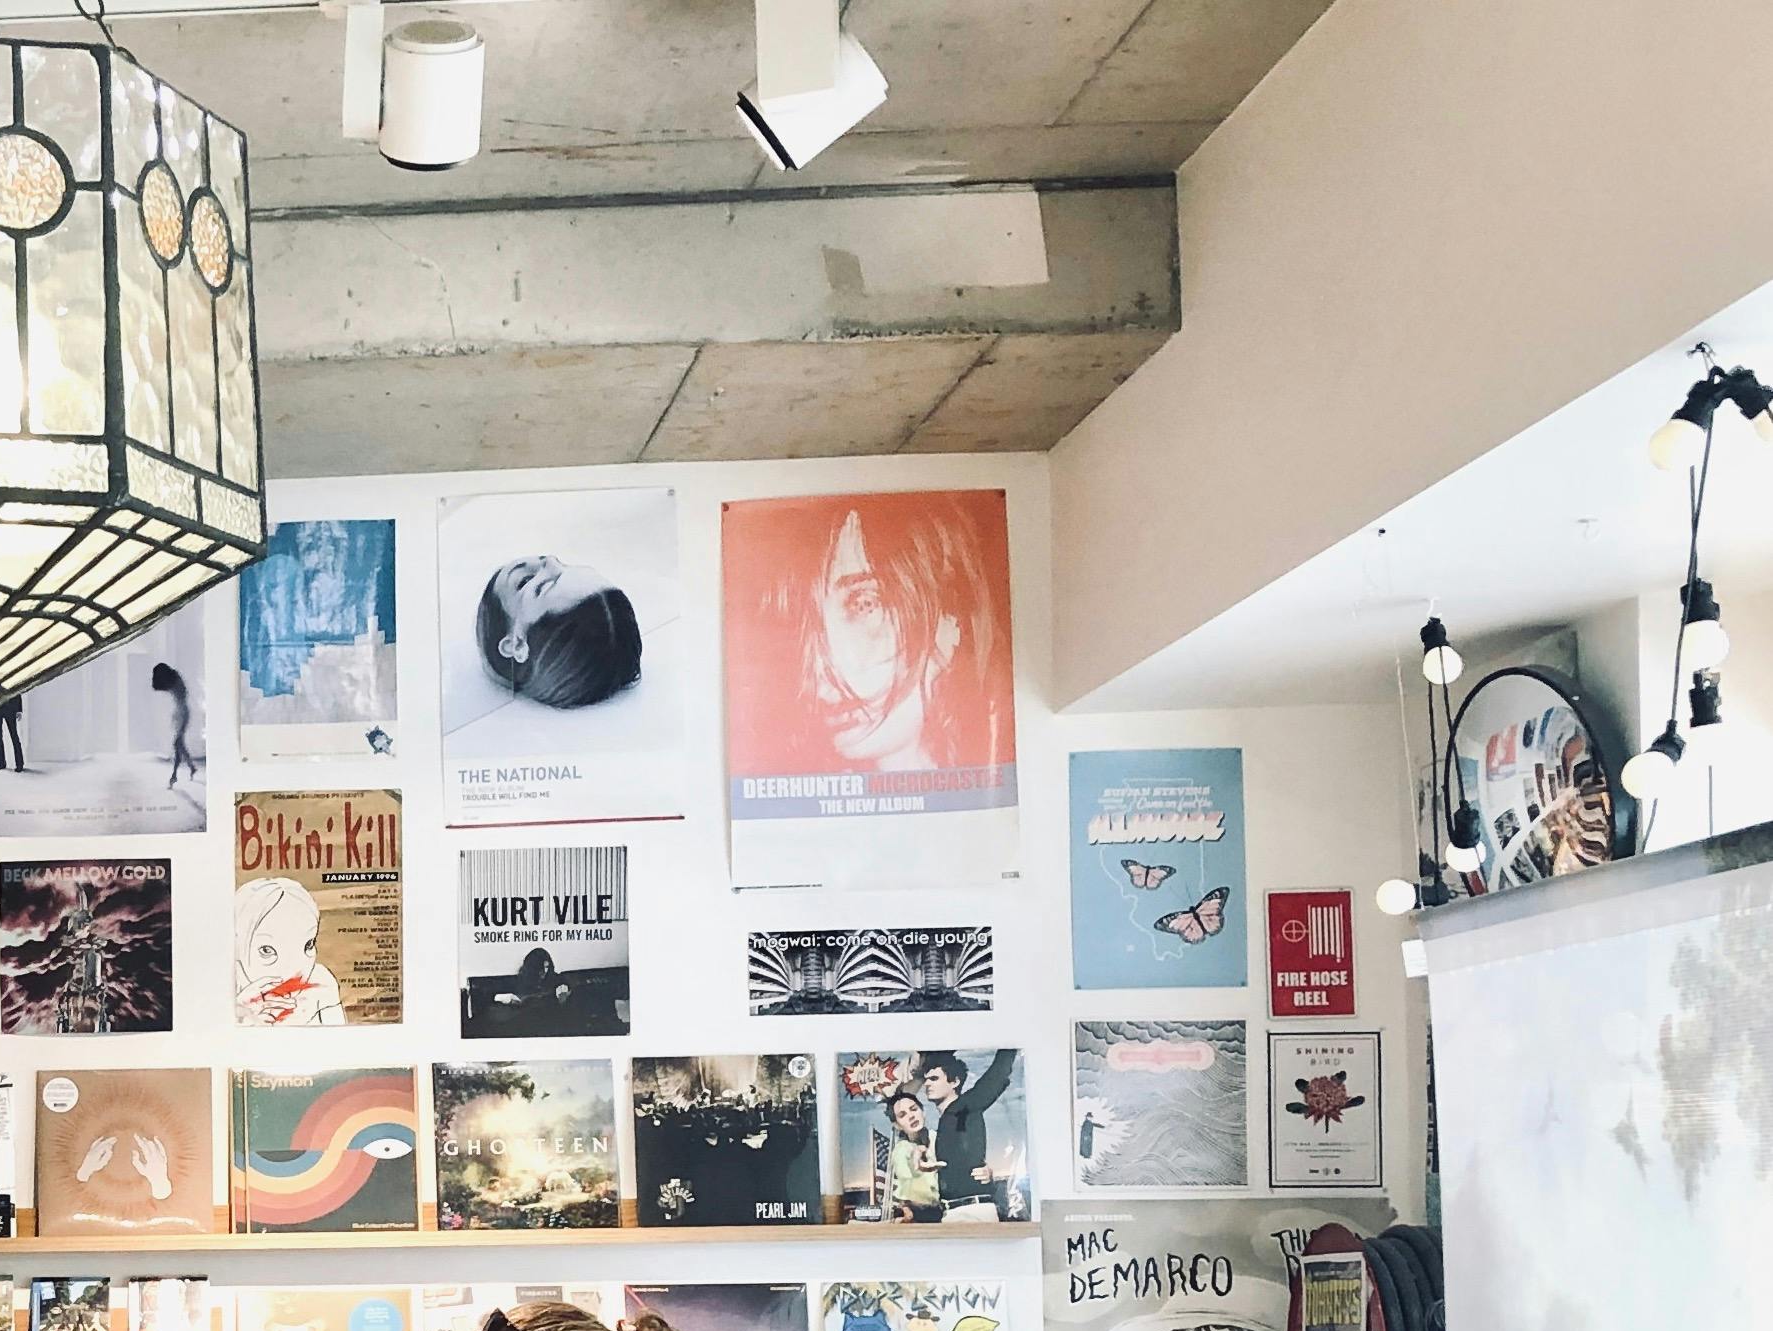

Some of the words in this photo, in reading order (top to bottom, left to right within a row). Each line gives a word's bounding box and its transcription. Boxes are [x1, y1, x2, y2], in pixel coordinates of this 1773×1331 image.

[458, 769, 491, 785] THE
[496, 765, 583, 783] NATIONAL
[462, 793, 497, 801] TROUBLE
[498, 792, 518, 801] WILL
[519, 791, 538, 800] FIND
[539, 791, 551, 799] ME
[743, 775, 864, 799] DEERHUNTER
[819, 799, 846, 815] THE
[846, 798, 875, 814] NEW
[878, 796, 925, 812] ALBUM
[239, 804, 334, 871] Bikini
[3, 867, 42, 883] BECK
[43, 866, 120, 882] MELLOW
[121, 865, 166, 880] GOLD
[325, 874, 375, 882] JANUARY
[473, 896, 544, 927] KURT
[553, 894, 613, 925] VILE
[474, 930, 510, 943] SMOKE
[513, 930, 539, 942] RING
[542, 929, 563, 942] FOR
[566, 929, 582, 941] MY
[585, 928, 613, 941] HALO
[826, 933, 872, 947] come
[876, 932, 898, 945] on
[902, 930, 930, 946] die
[934, 930, 989, 948] young
[1277, 971, 1308, 988] FIRE
[1310, 970, 1349, 987] HOSE
[1293, 990, 1330, 1007] REEL
[1296, 1046, 1355, 1056] SHINING
[1310, 1057, 1341, 1067] BIRD
[251, 1076, 314, 1091] Szymon
[443, 1136, 609, 1156] GHOTEEN
[756, 1202, 787, 1218] PEARL
[787, 1202, 807, 1218] JAM
[1066, 1227, 1120, 1267] MAC
[911, 1282, 1003, 1313] LEMON
